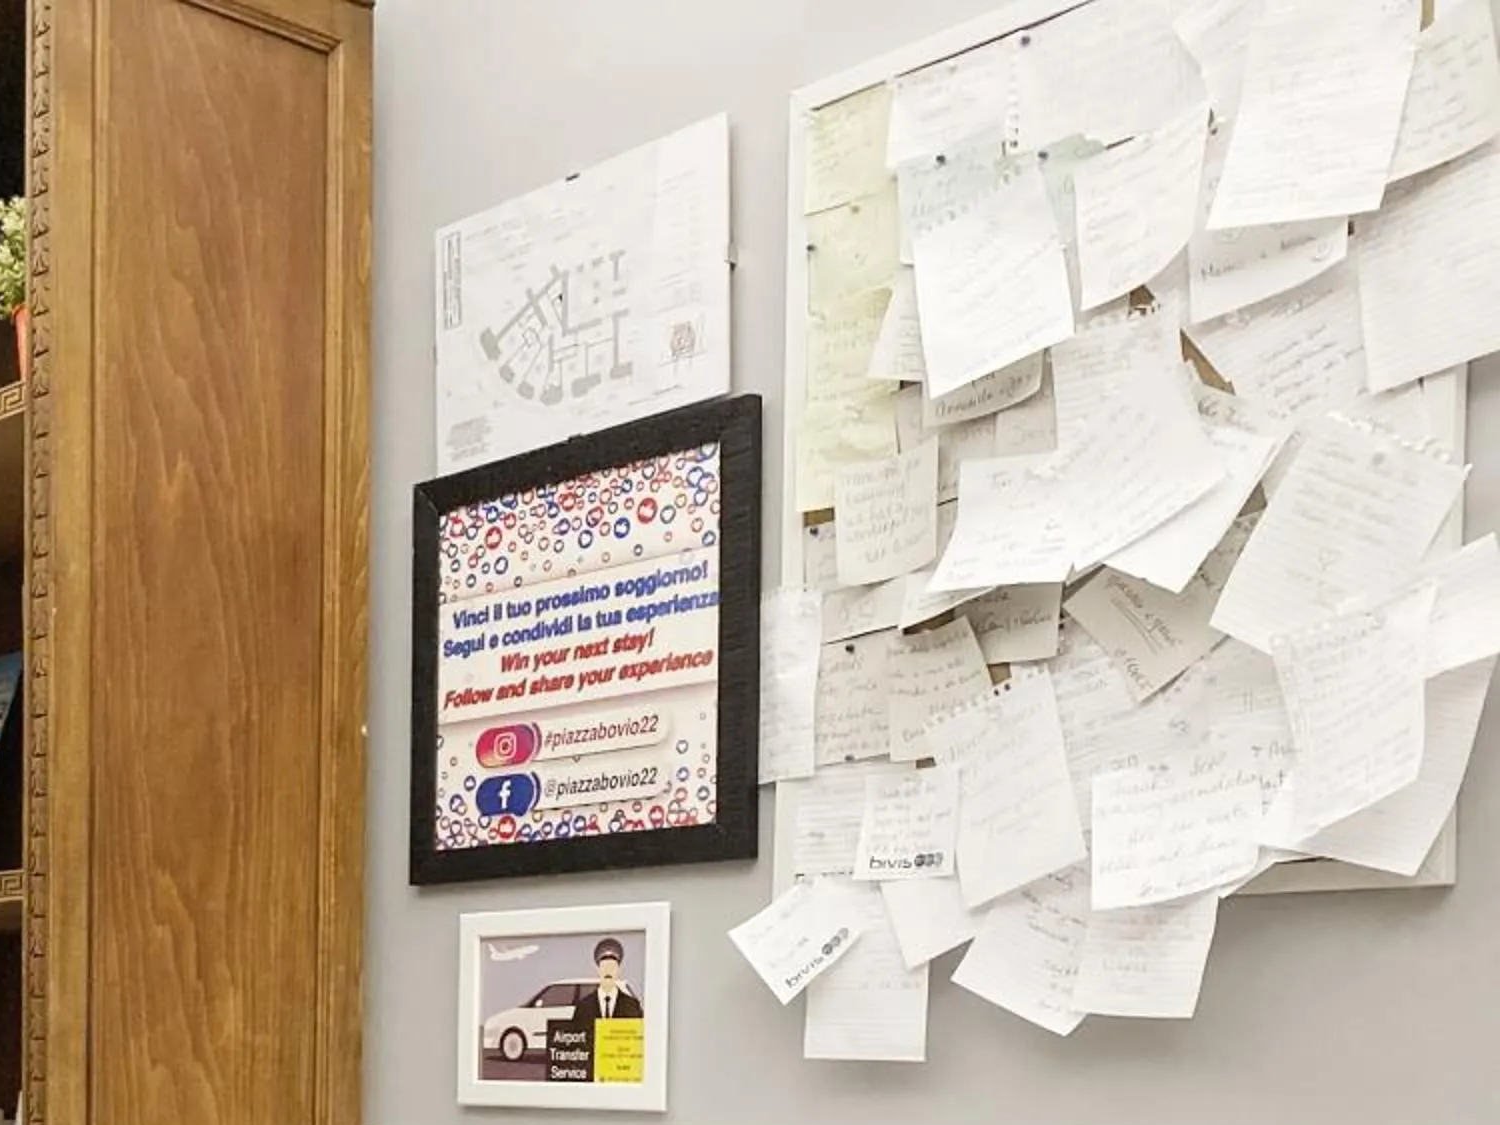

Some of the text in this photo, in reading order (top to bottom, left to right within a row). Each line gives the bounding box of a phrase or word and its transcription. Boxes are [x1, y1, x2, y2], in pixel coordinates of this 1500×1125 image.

[453, 560, 708, 629] Vinci il tuo prossimo soggiorno!
[443, 633, 485, 659] Segui
[489, 632, 498, 649] e
[502, 614, 573, 647] condividi
[577, 610, 592, 629] la
[596, 605, 622, 625] tua
[501, 627, 656, 673] Win your next stay!
[443, 649, 714, 710] Follow and share your experience
[544, 714, 659, 752] #piazzabovio22
[544, 766, 658, 800] @piazzabovio22
[550, 1048, 590, 1062] Transfer
[553, 1031, 587, 1045] Airport
[551, 1065, 587, 1080] Service
